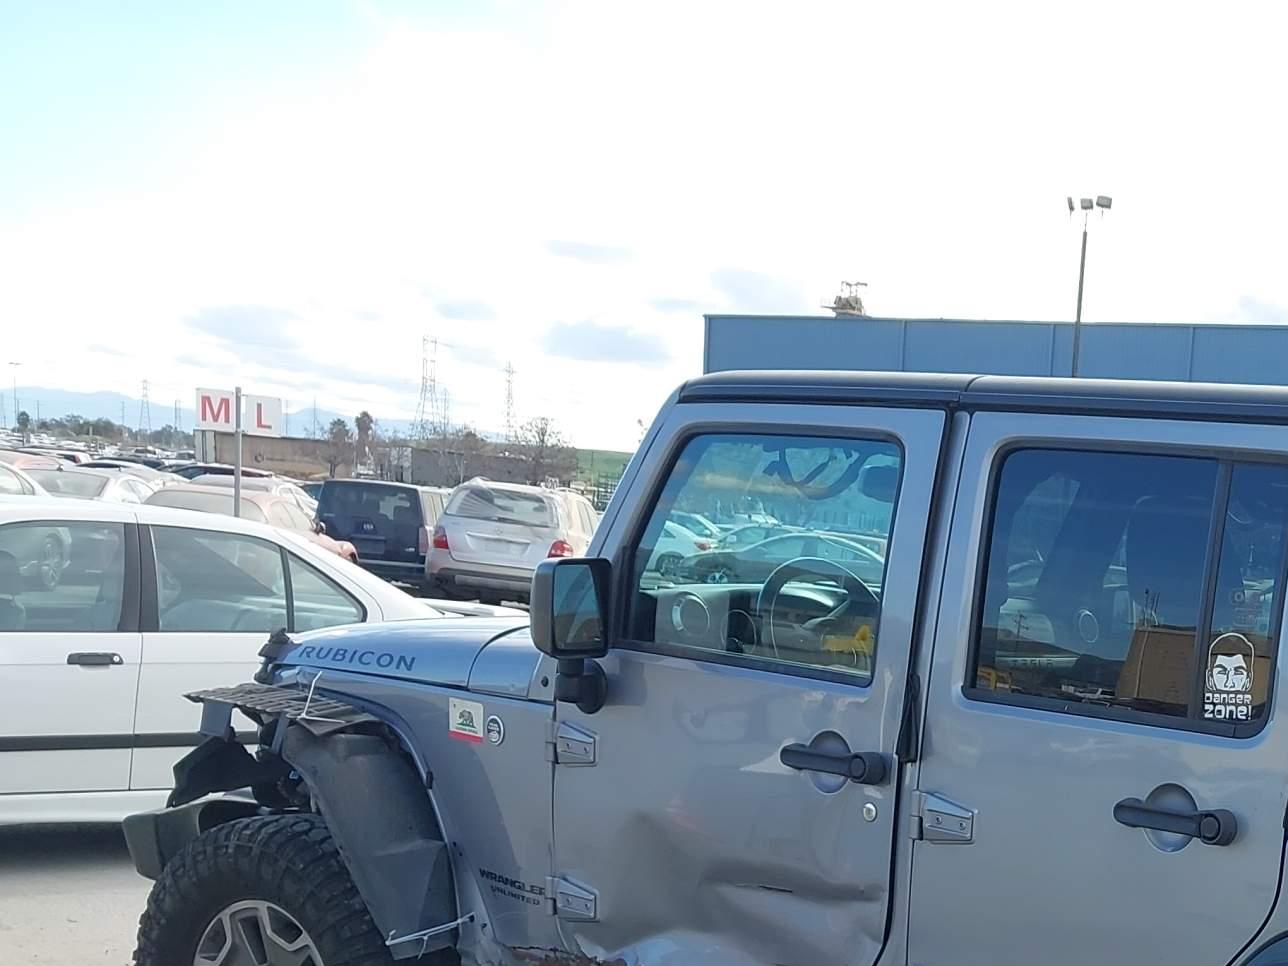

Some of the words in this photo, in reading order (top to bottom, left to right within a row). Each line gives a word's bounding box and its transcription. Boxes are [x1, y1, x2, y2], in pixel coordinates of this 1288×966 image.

[201, 396, 230, 424] M
[256, 403, 273, 430] L
[298, 645, 416, 672] RUBICON
[490, 885, 541, 906] UNLIMITED
